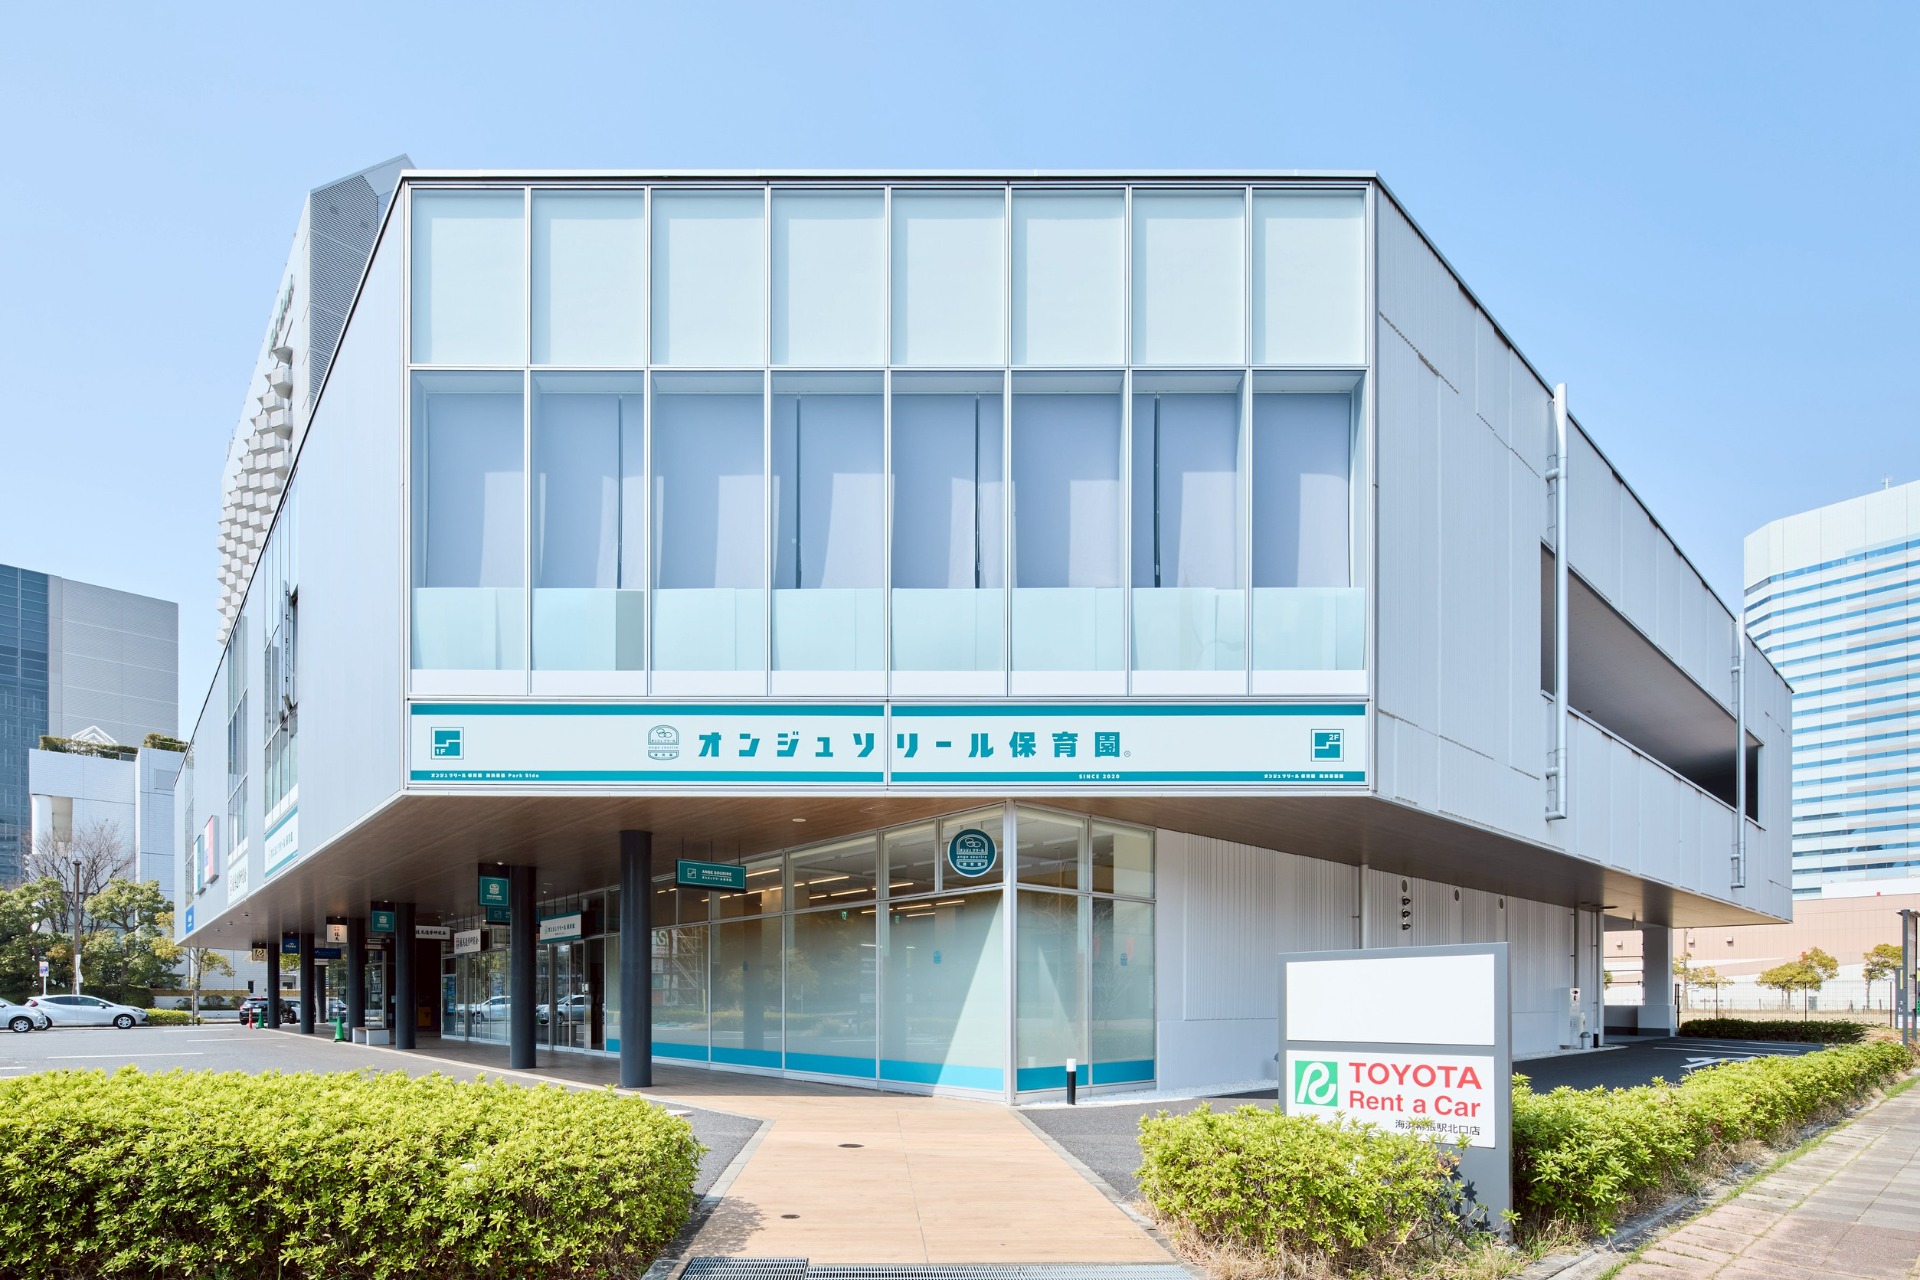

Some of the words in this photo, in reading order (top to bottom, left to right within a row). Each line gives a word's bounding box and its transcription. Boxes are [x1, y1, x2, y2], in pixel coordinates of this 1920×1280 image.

[698, 731, 1120, 758] オンジュソリール保育園
[1349, 1062, 1482, 1090] TOYOTA
[1349, 1090, 1403, 1112] Rent
[1412, 1098, 1426, 1114] a
[1434, 1095, 1481, 1118] Car
